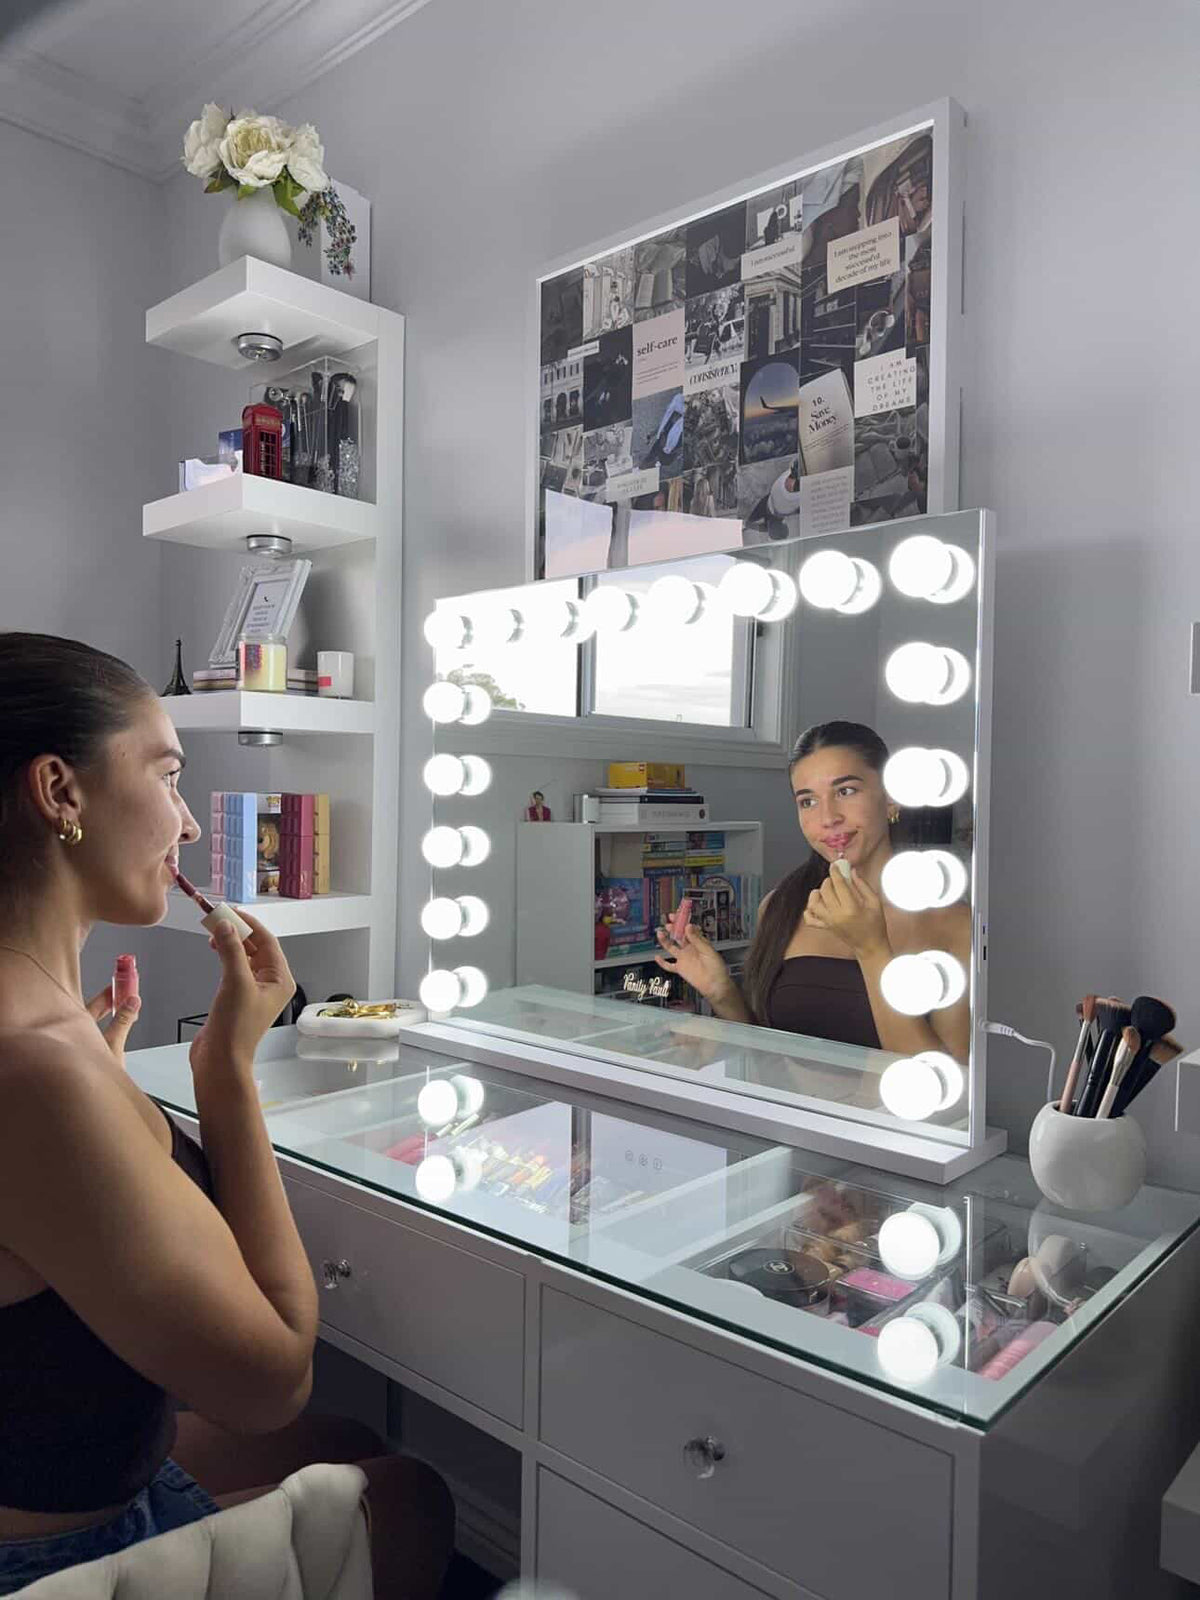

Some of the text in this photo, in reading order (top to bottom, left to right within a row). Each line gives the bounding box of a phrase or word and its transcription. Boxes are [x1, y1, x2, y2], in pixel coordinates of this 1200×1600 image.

[637, 336, 678, 357] self-care
[867, 365, 915, 384] CREATING
[870, 376, 911, 393] THE LIFE
[872, 396, 911, 411] DREAMS
[876, 388, 906, 401] OF MY
[623, 972, 648, 1001] Vanity
